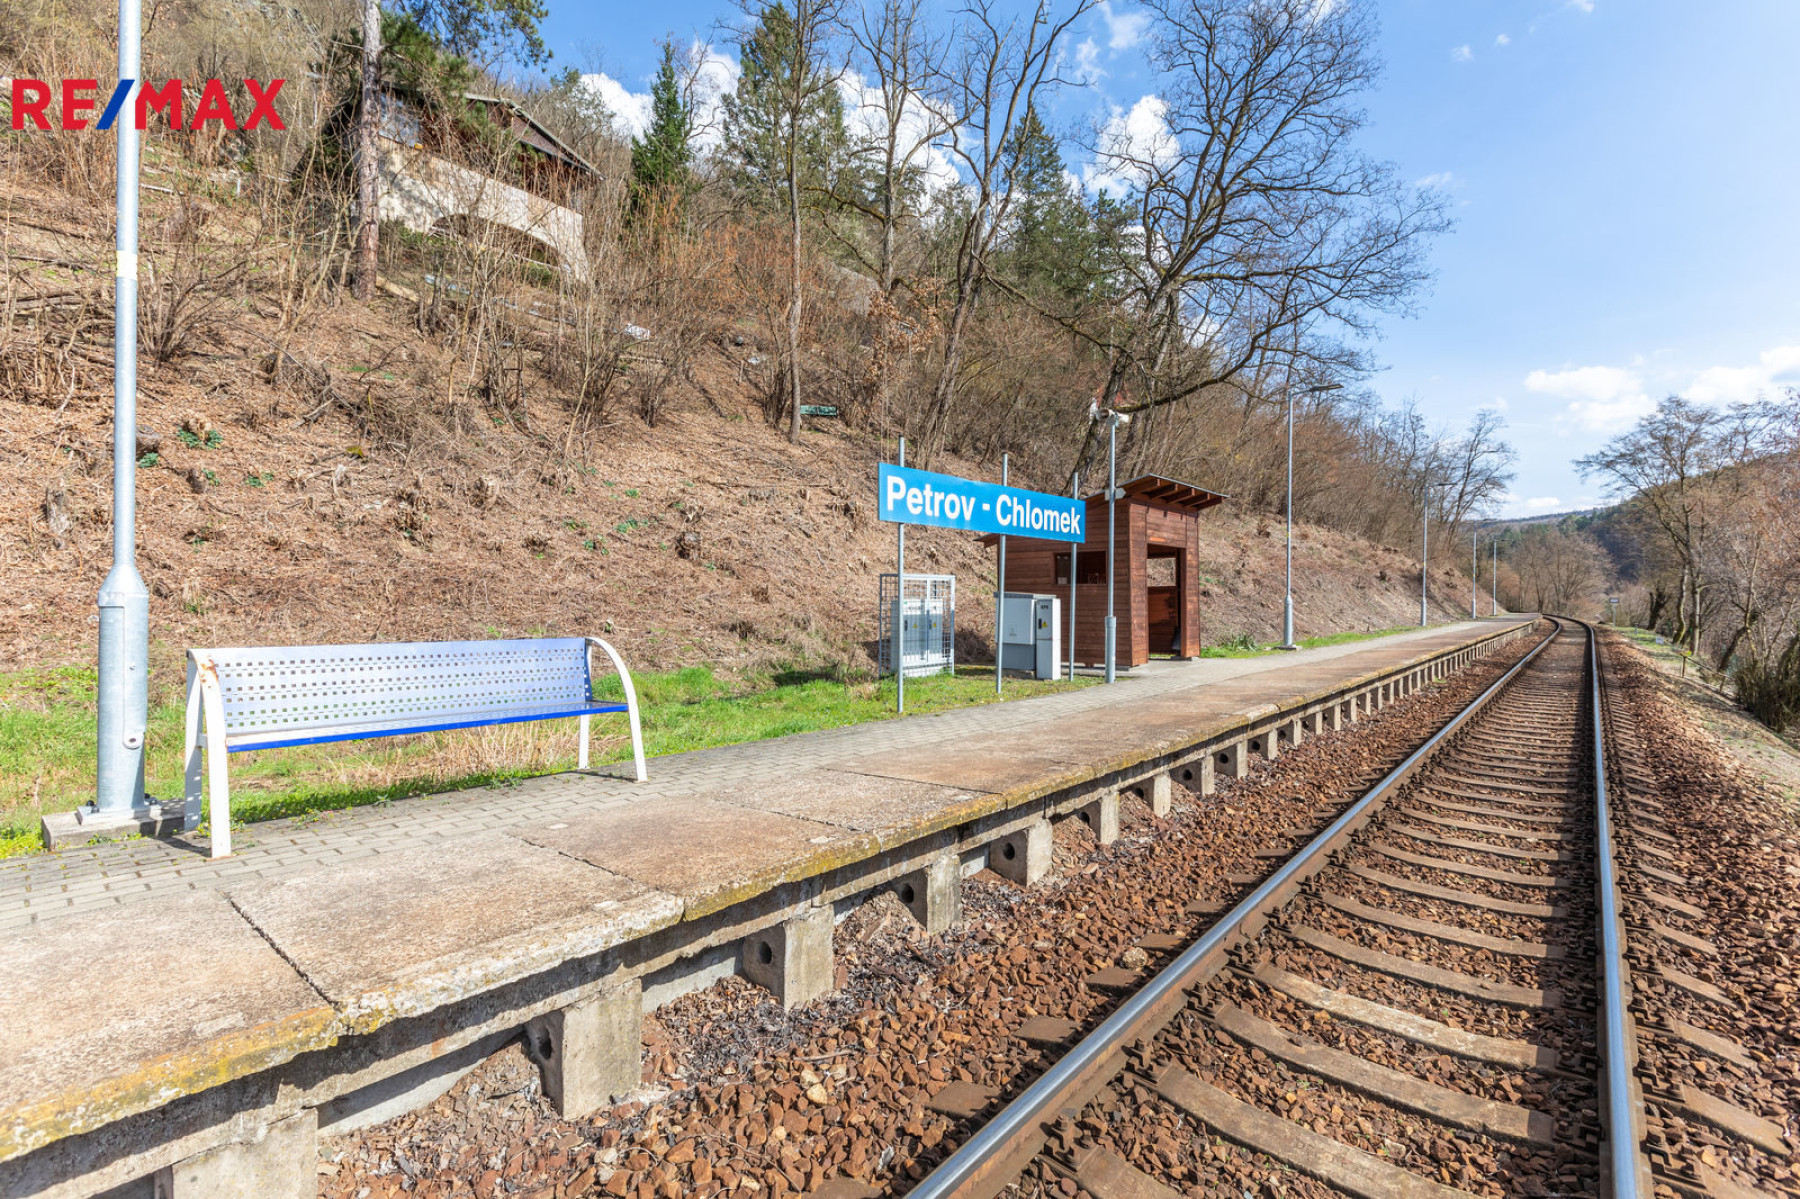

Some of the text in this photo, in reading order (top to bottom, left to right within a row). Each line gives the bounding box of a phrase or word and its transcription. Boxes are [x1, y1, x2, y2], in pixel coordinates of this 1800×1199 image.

[887, 475, 1081, 535] Petrov - Chlomek
